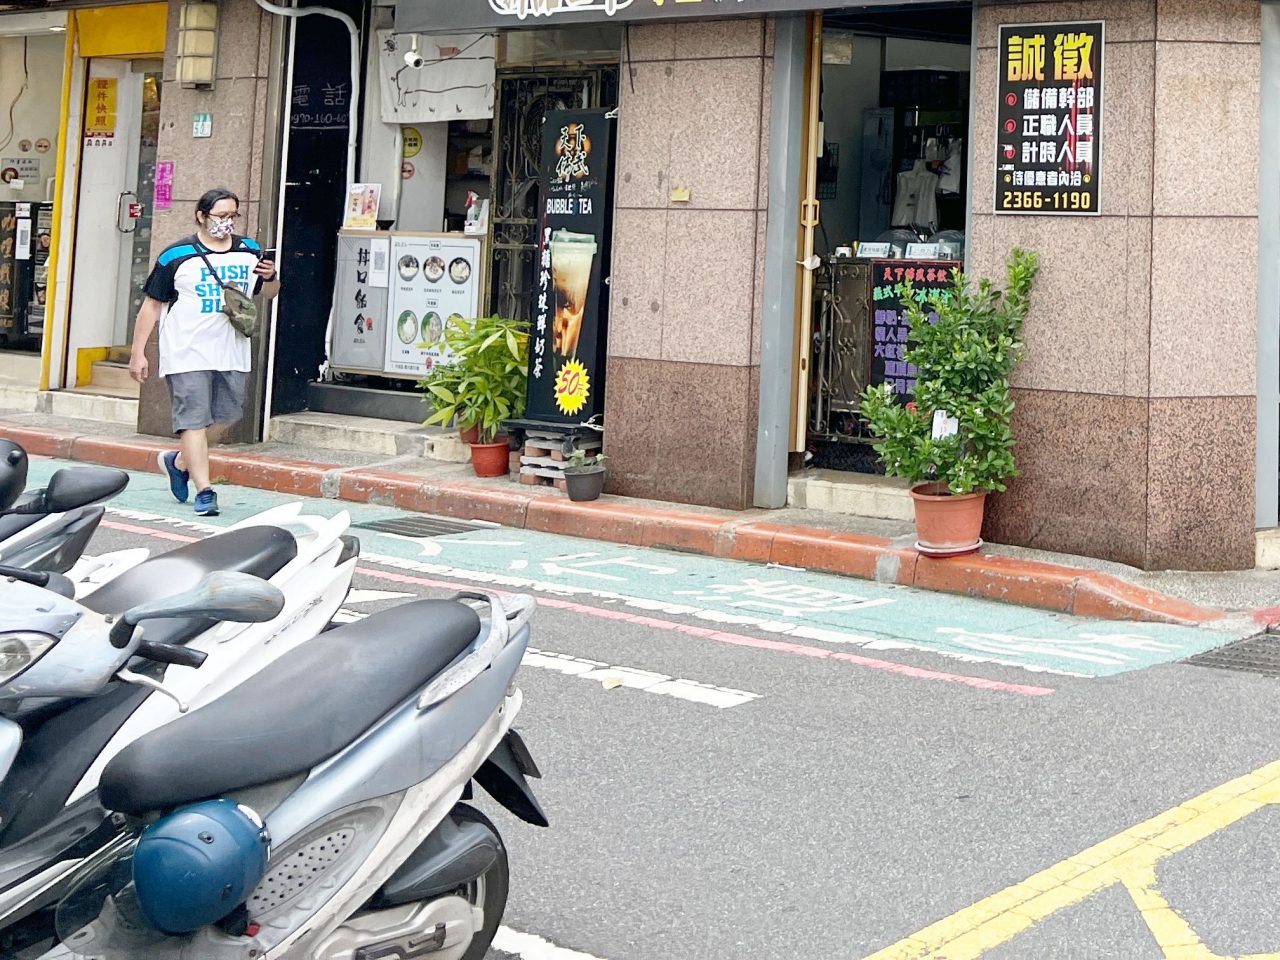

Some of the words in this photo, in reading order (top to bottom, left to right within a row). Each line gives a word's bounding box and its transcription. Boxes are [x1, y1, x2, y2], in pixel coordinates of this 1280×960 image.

[1007, 32, 1094, 82] 誠徵
[1023, 87, 1095, 109] 儲備幹部
[1022, 114, 1094, 137] 正職人員
[1021, 141, 1094, 163] 計時人員
[546, 198, 574, 214] BUBBLE
[579, 198, 593, 214] TEA
[1003, 191, 1091, 209] 2366-1190
